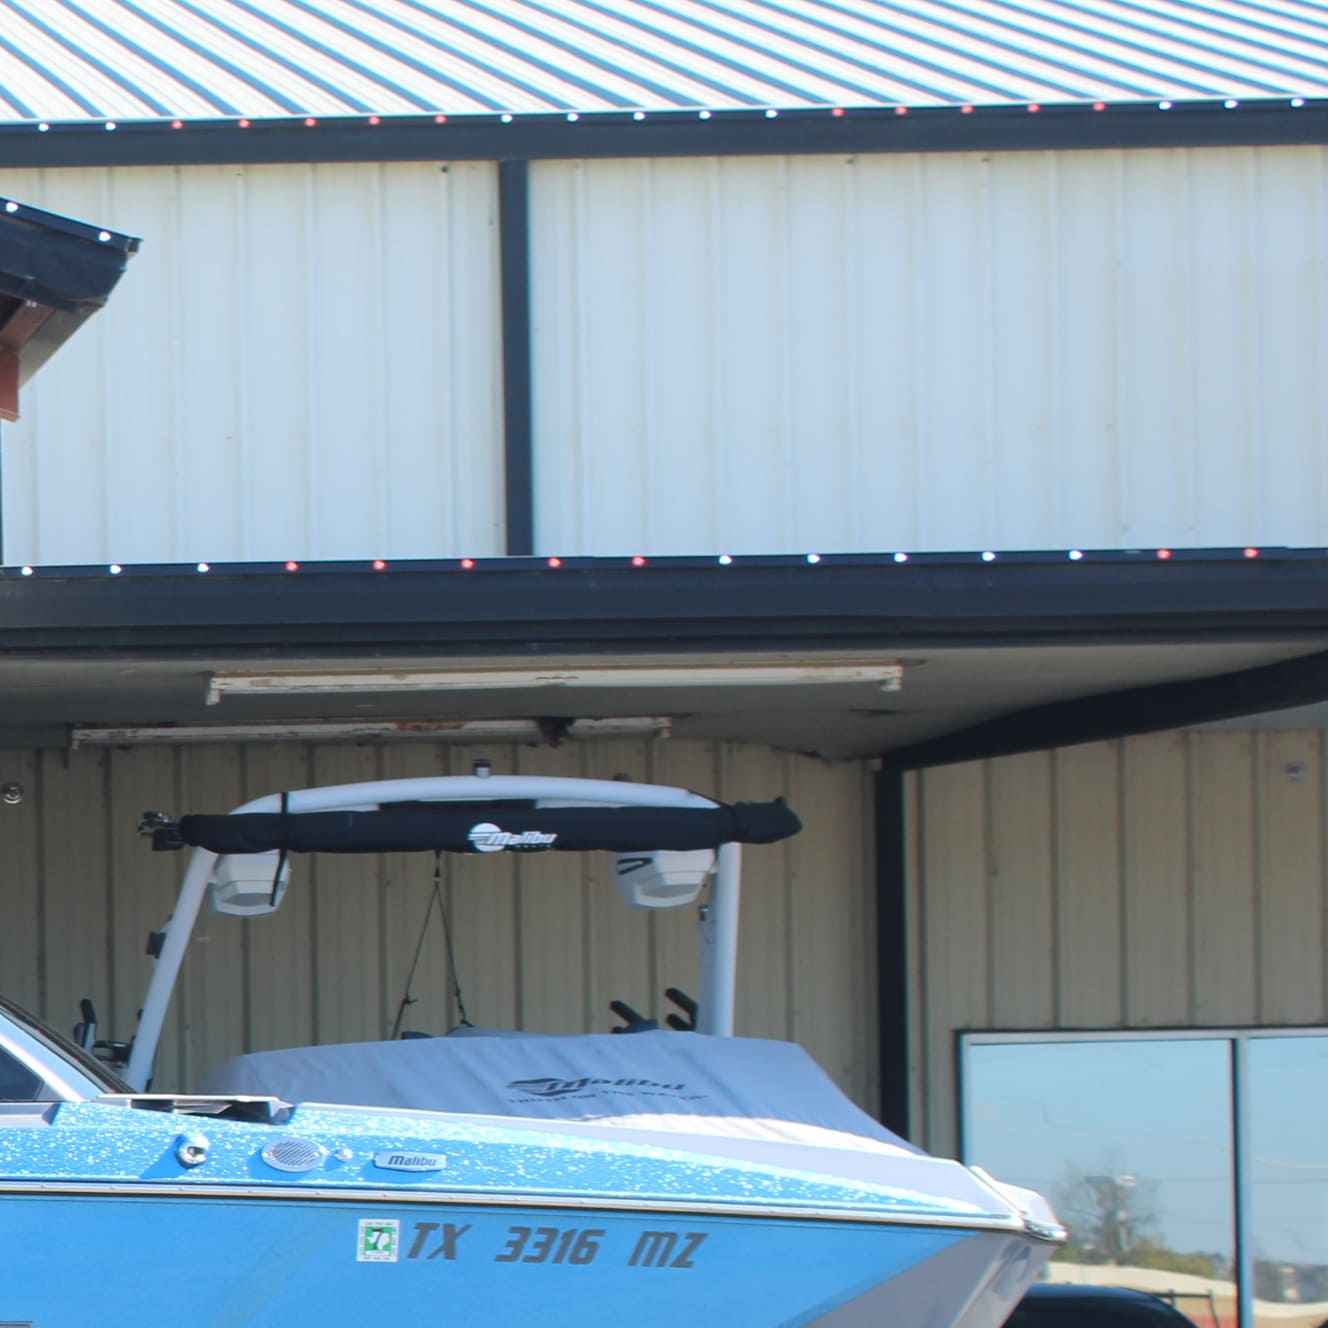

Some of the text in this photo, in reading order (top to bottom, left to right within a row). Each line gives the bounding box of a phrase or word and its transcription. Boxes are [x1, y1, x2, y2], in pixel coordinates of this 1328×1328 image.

[388, 1155, 437, 1167] Malibu
[406, 1222, 710, 1268] TX 3316 MZ
